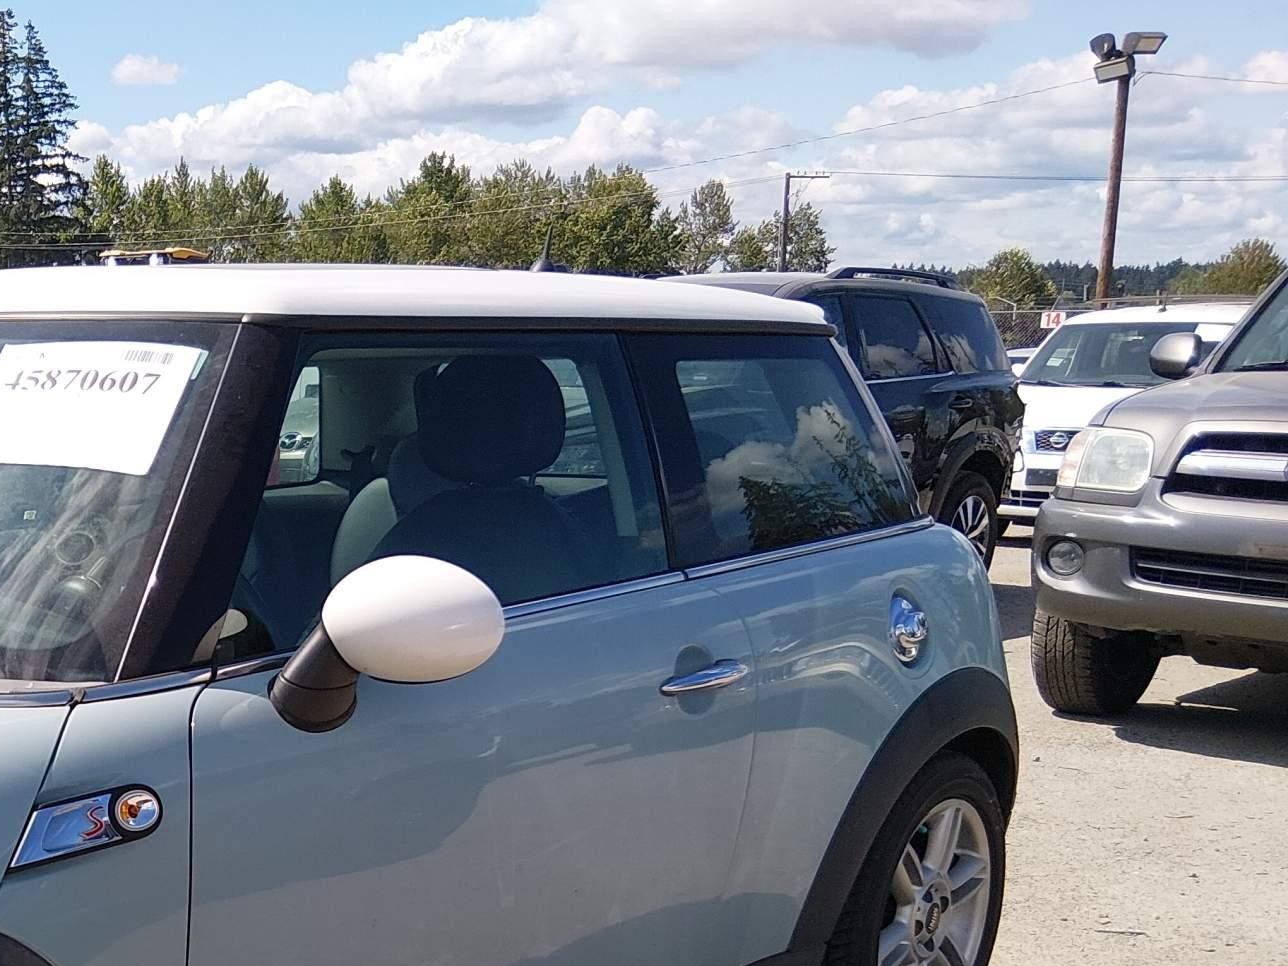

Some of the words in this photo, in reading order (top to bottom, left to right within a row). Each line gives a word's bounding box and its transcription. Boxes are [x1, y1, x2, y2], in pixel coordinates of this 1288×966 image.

[1045, 312, 1062, 327] 14
[4, 368, 162, 395] 45870607
[80, 805, 105, 841] S
[927, 906, 939, 930] MINI
